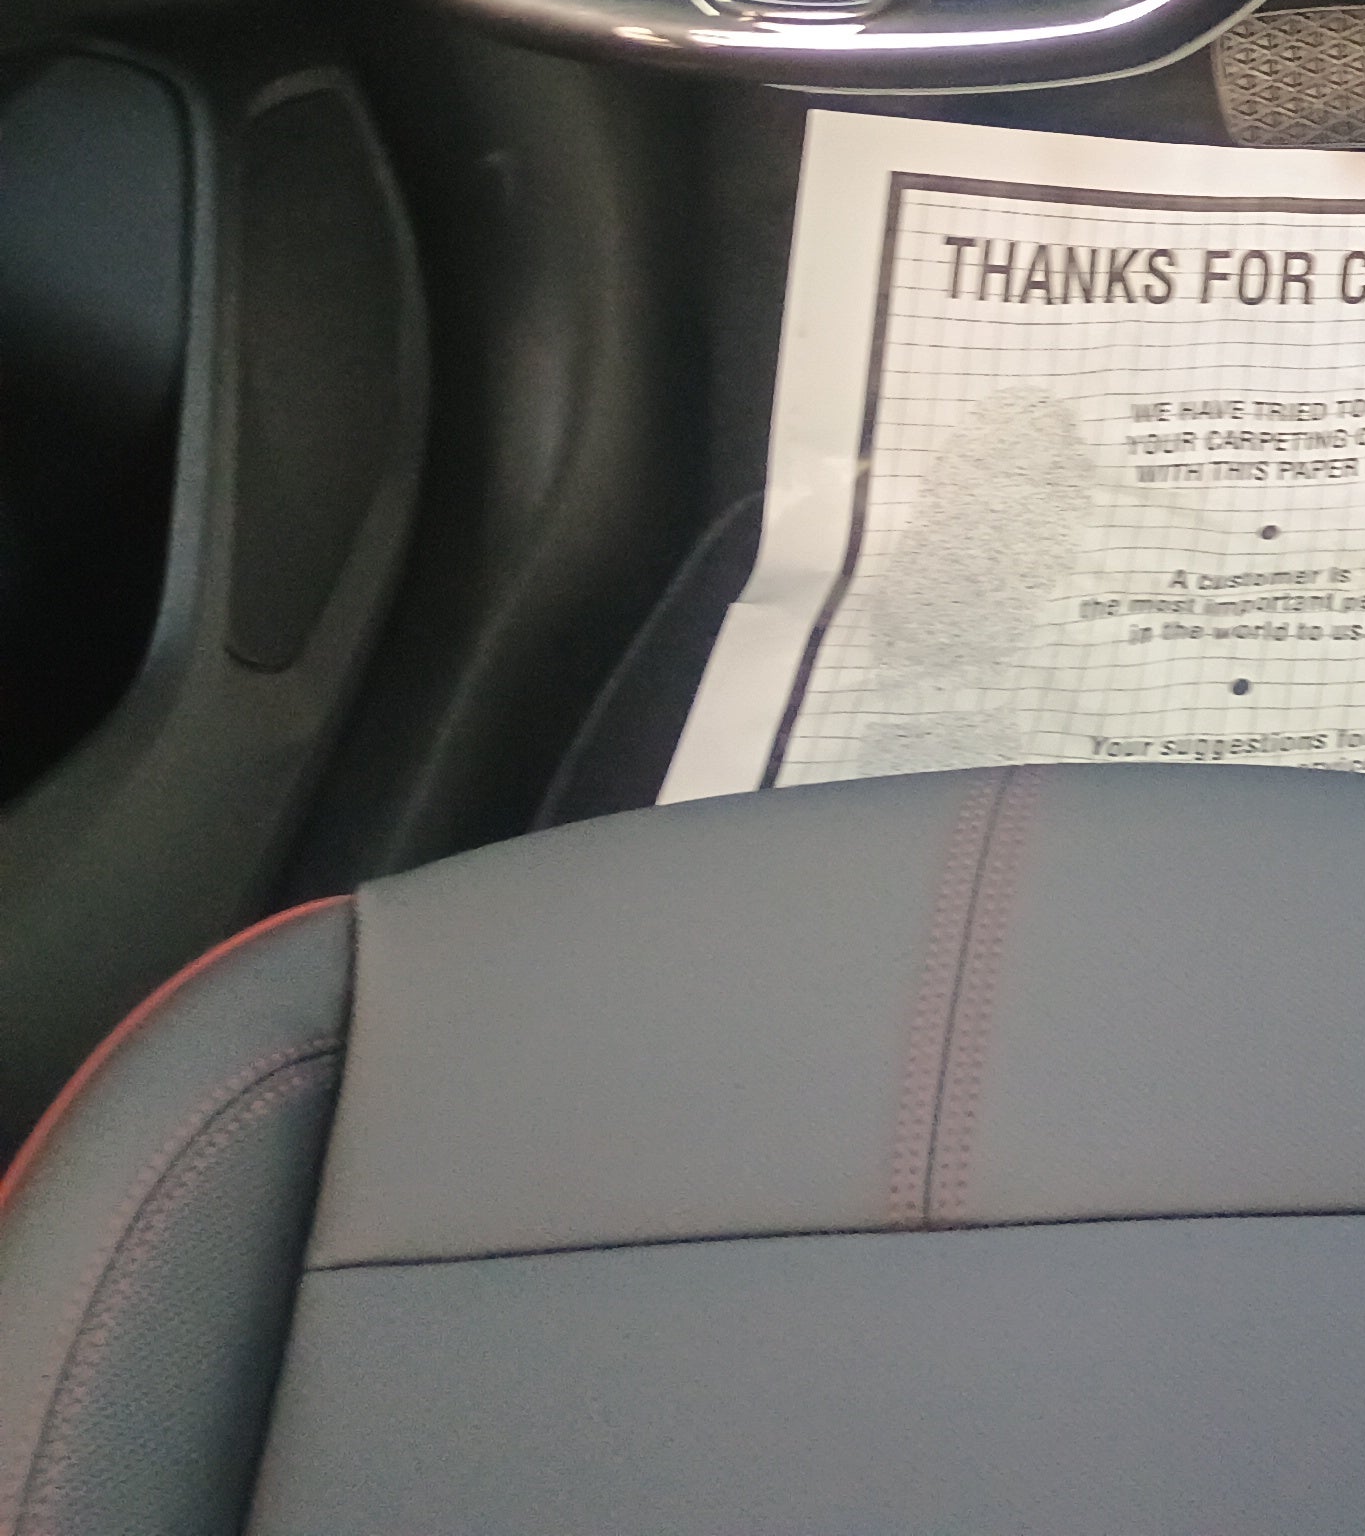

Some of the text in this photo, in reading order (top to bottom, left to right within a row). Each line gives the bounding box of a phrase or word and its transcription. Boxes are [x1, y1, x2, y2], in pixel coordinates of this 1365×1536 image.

[944, 236, 1176, 304] THANKS
[1201, 249, 1314, 305] FOR
[1131, 402, 1173, 422] WE
[1178, 400, 1244, 420] HAVE
[1253, 401, 1327, 421] TRIED
[1127, 431, 1196, 455] YOUR
[1204, 428, 1348, 452] CARPETING
[1136, 463, 1200, 482] WITH
[1208, 461, 1268, 481] THIS
[1275, 457, 1359, 480] PAPER
[1168, 567, 1352, 590] A customer is
[1079, 598, 1119, 617] the
[1127, 598, 1195, 613] most
[1202, 593, 1334, 616] important
[1128, 623, 1152, 646] in
[1161, 621, 1205, 641] the
[1212, 621, 1290, 642] world
[1297, 622, 1323, 641] to
[1091, 736, 1153, 757] Your
[1160, 732, 1328, 761] suggestions
